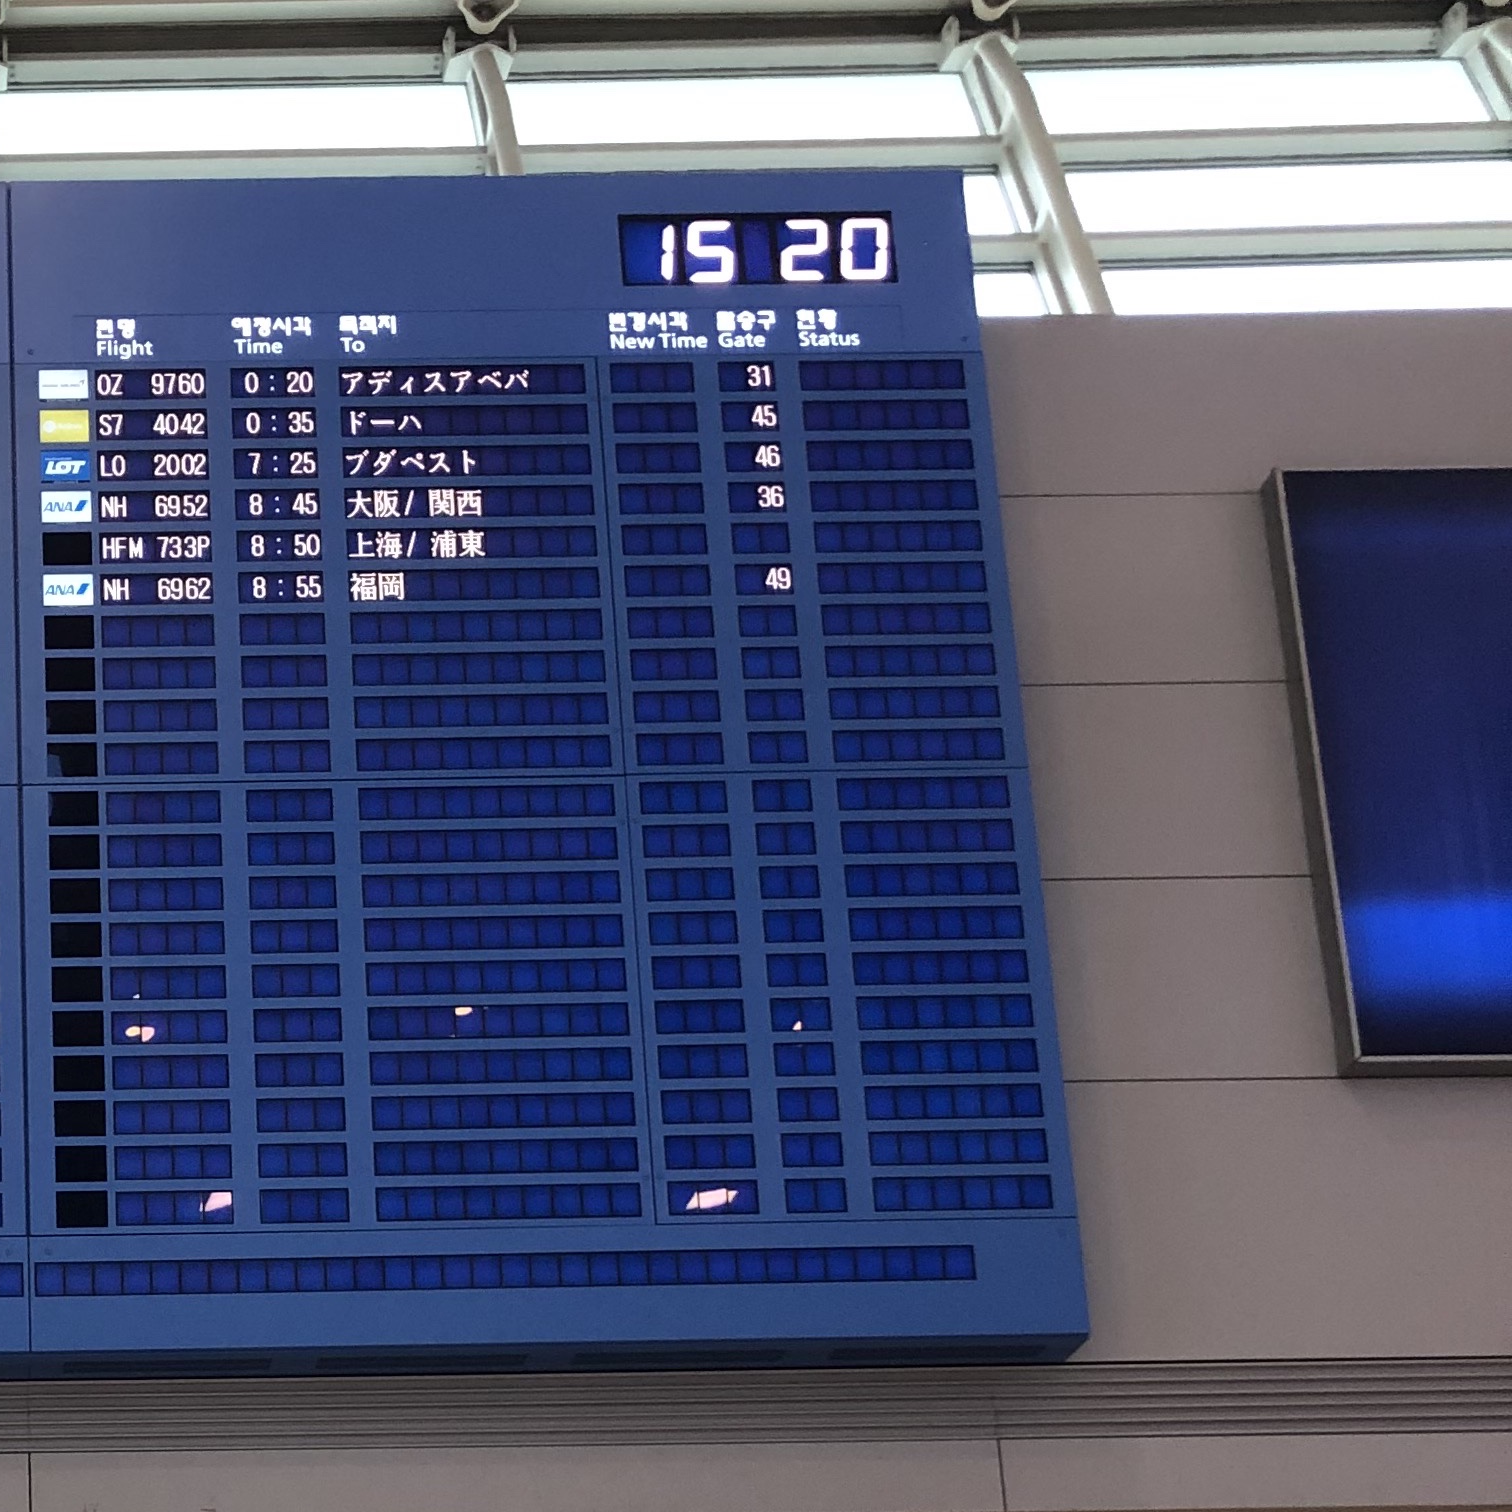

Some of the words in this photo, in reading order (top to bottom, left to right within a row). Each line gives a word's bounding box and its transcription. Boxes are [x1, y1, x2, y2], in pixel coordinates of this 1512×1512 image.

[234, 339, 283, 354] Time
[341, 338, 365, 353] To
[610, 334, 657, 350] New
[660, 333, 708, 349] Time
[718, 333, 766, 348] Gate
[798, 332, 860, 347] Status
[97, 340, 153, 360] Flight
[97, 374, 122, 395] OZ
[151, 373, 204, 394] 9760
[747, 366, 770, 386] 31
[99, 414, 123, 435] S7
[153, 413, 204, 435] 4042
[752, 405, 776, 426] 45
[101, 455, 125, 476] LO
[154, 454, 206, 476] 2002
[755, 445, 780, 467] 46
[45, 460, 86, 474] LOT
[43, 501, 73, 512] ANA
[102, 496, 126, 517] NH
[155, 495, 207, 517] 6952
[758, 486, 784, 507] 36
[103, 537, 143, 559] HFM
[157, 536, 210, 558] 733P
[766, 568, 791, 589] 49
[45, 584, 75, 595] ANA
[104, 579, 129, 600] NH
[158, 578, 210, 600] 6962
